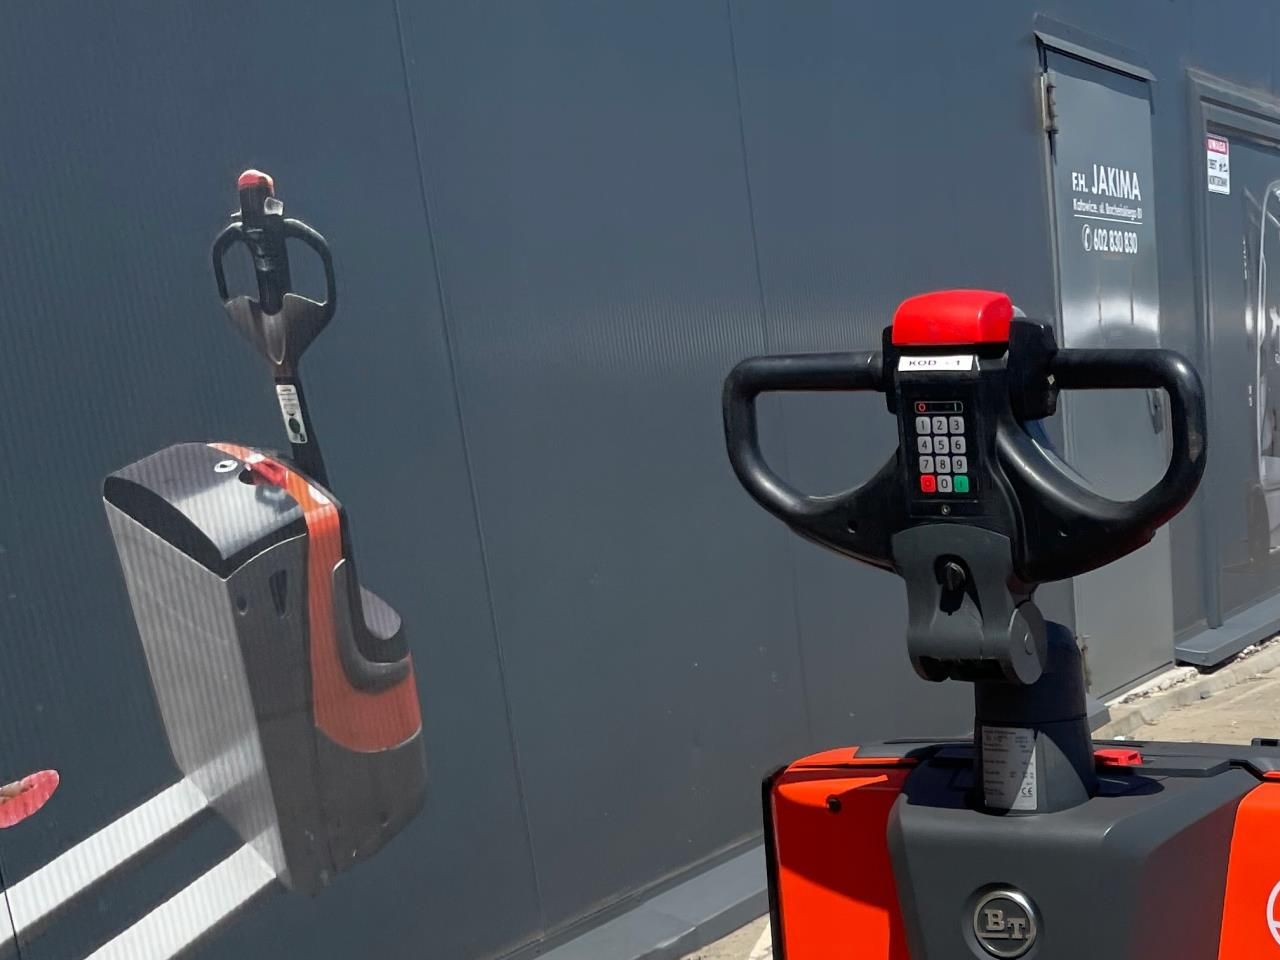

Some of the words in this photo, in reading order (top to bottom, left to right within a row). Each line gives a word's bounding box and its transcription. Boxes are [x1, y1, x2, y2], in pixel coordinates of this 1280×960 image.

[1072, 172, 1089, 193] F.H.
[1092, 164, 1142, 201] JAKIMA
[1093, 228, 1108, 252] 602
[1109, 229, 1124, 253] 830
[1124, 231, 1138, 254] 830
[908, 359, 937, 367] KOD
[984, 908, 1026, 939] BT
